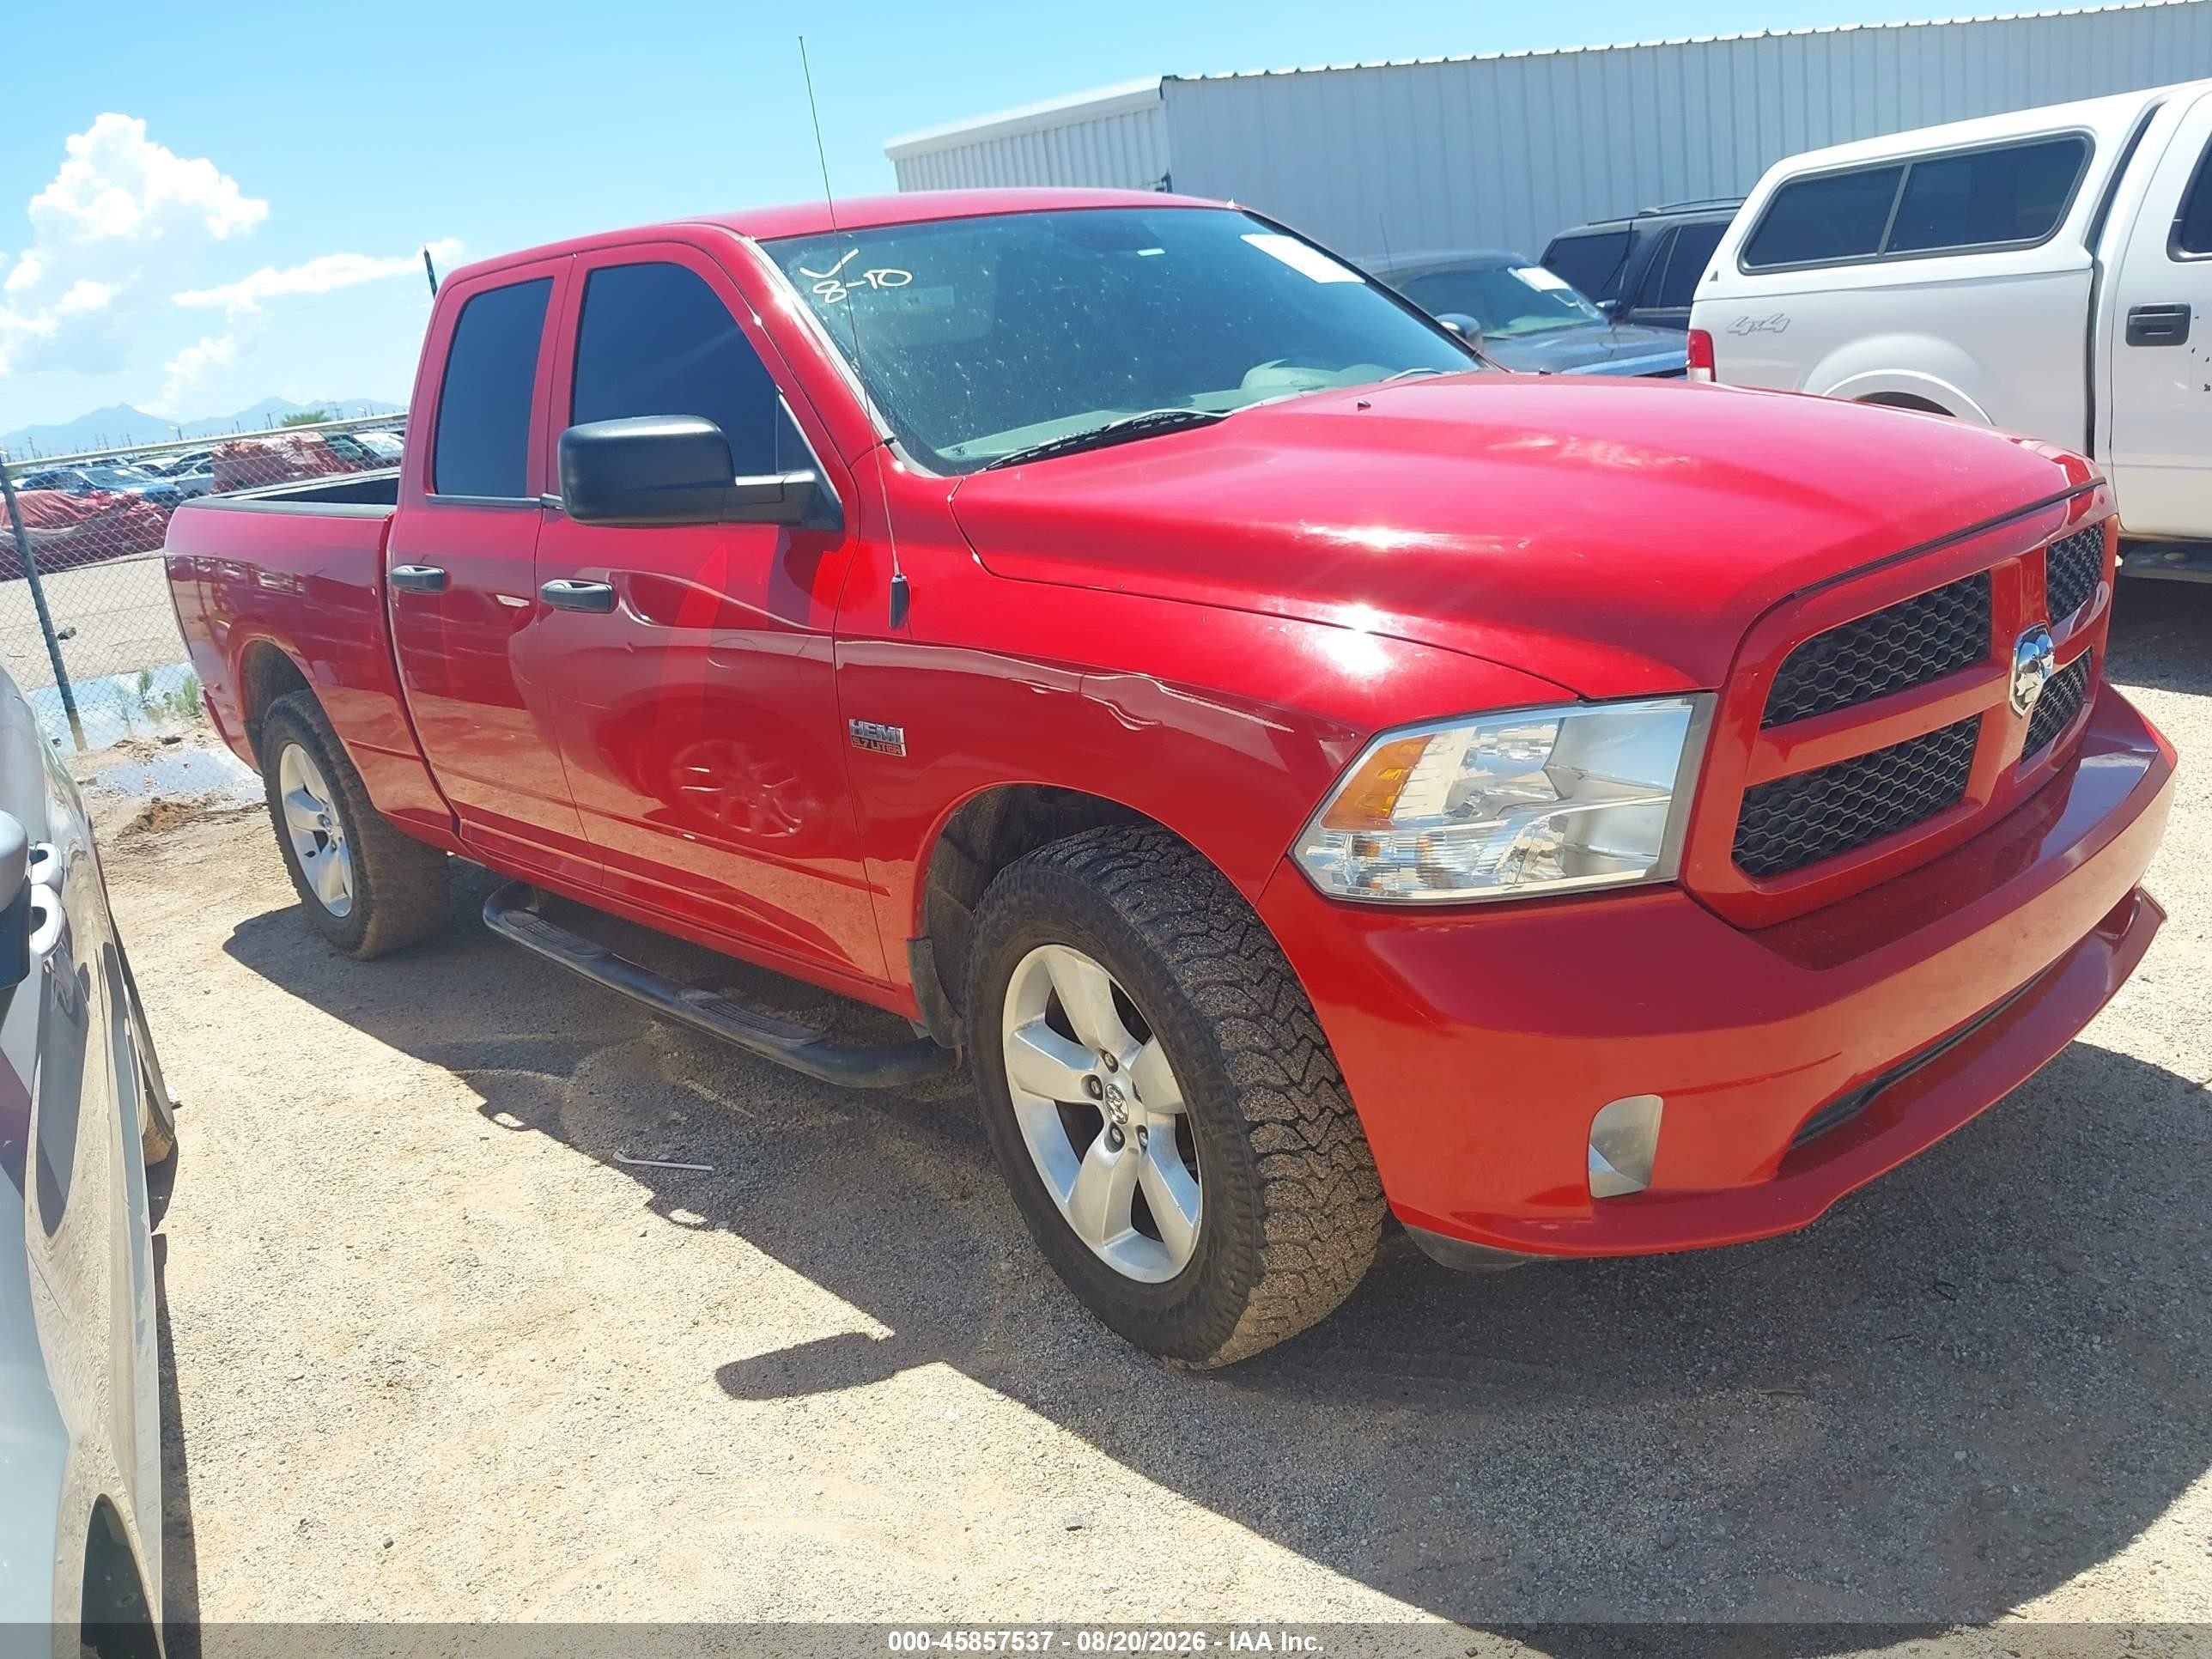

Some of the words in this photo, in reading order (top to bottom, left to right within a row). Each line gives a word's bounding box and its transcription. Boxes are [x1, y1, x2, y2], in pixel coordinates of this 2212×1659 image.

[812, 267, 913, 304] 8-10
[1726, 313, 1791, 337] 4x4
[848, 718, 905, 744] HEMI
[870, 739, 902, 755] LITER
